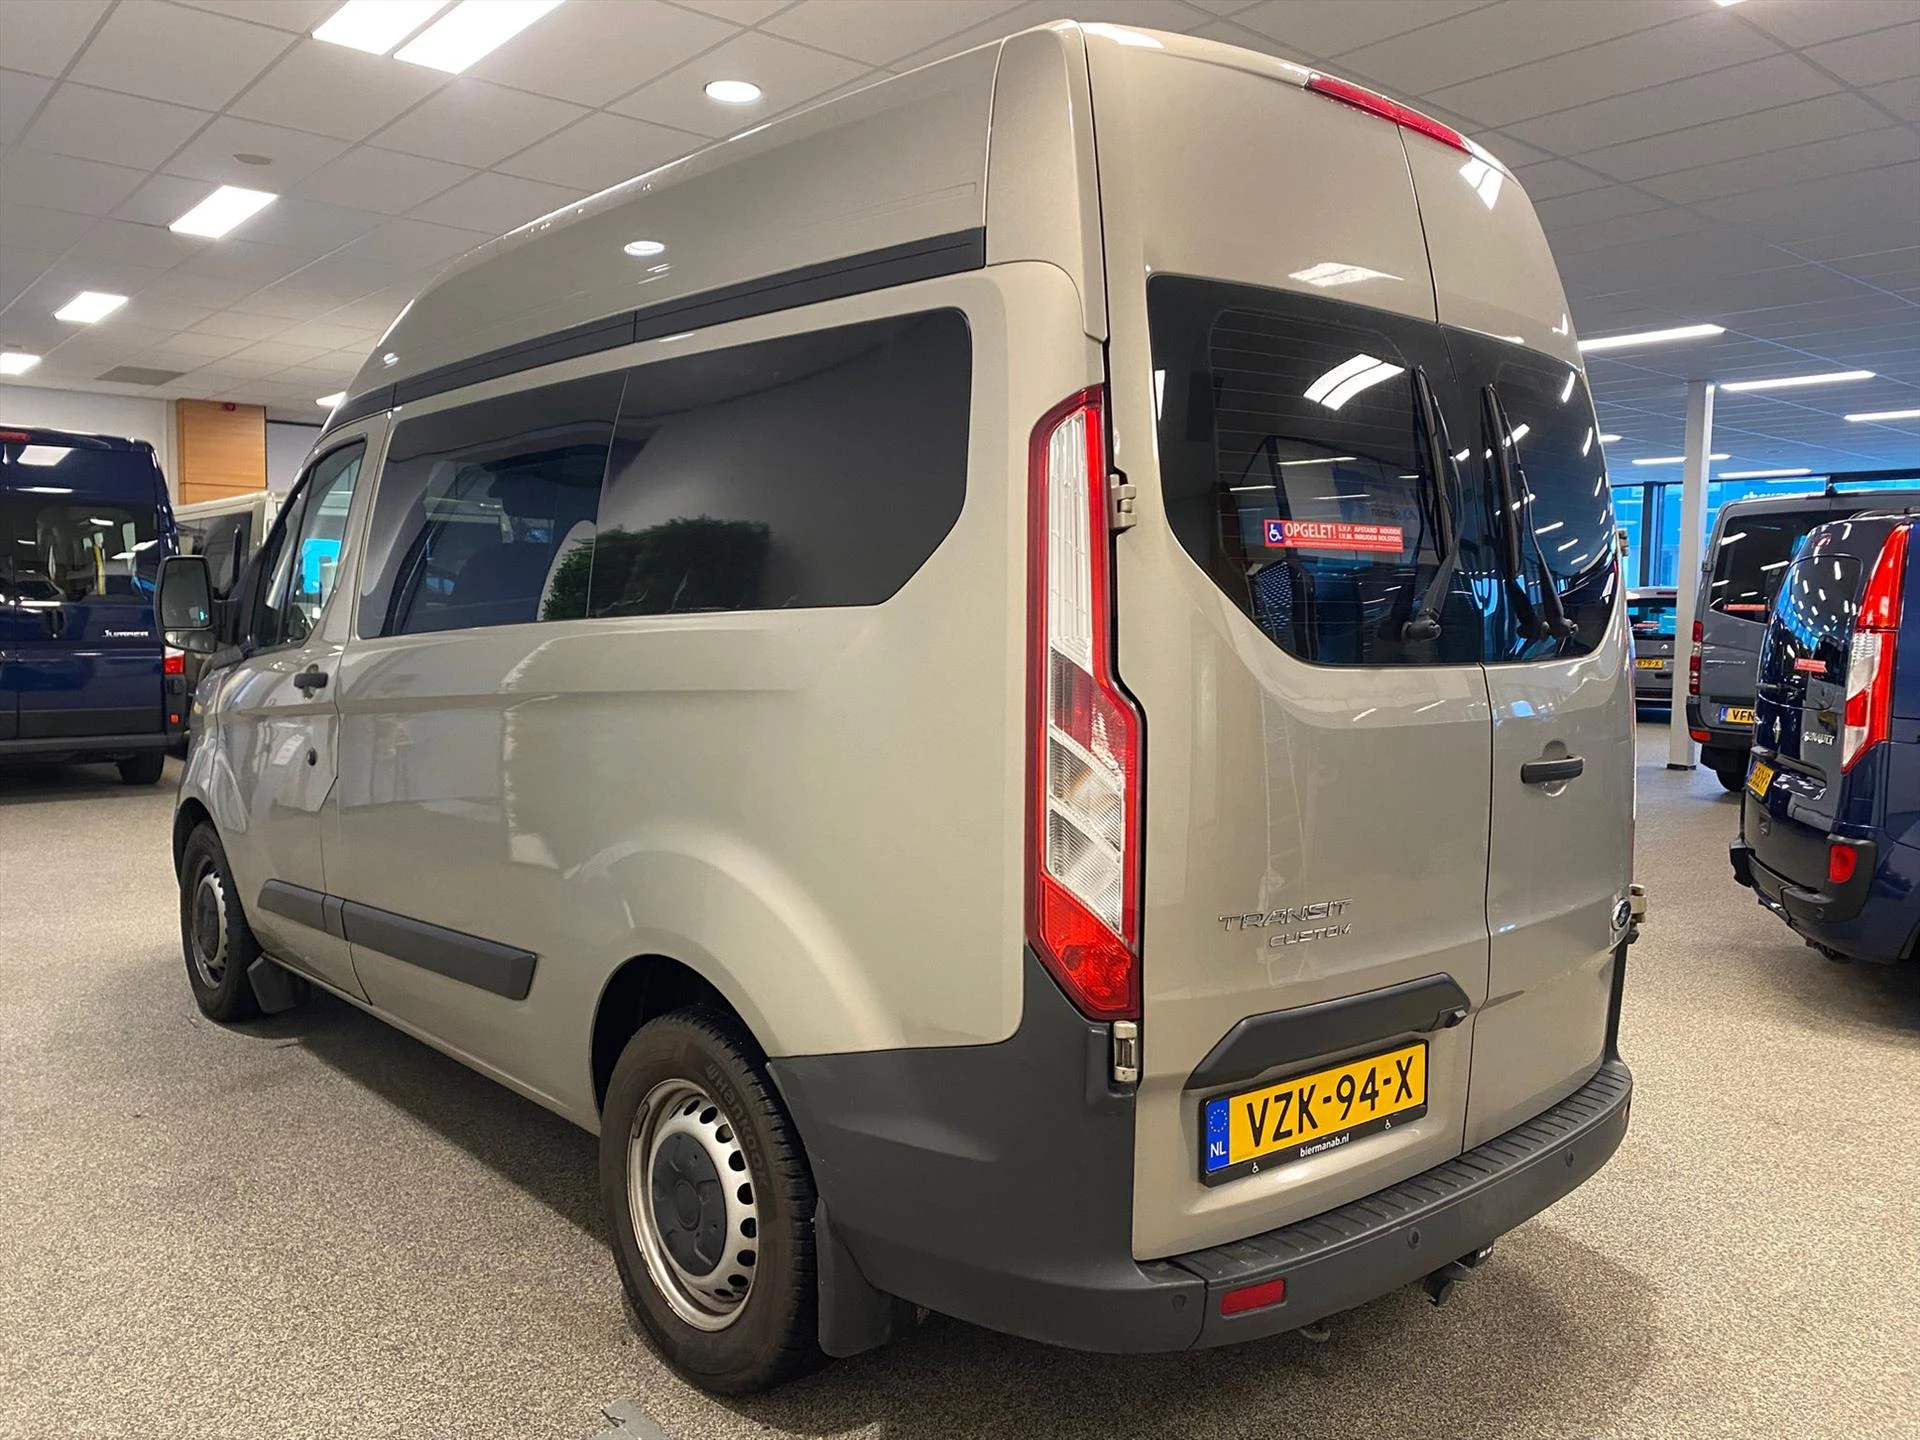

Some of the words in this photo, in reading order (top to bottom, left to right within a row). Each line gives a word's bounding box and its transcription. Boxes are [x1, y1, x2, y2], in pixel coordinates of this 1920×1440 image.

[1285, 523, 1337, 538] OPGELET!
[1218, 898, 1352, 931] TRANSIT
[1269, 923, 1351, 947] CUSTOM
[1246, 1056, 1413, 1148] VZK-94-X
[1210, 1140, 1226, 1158] NL
[1300, 1133, 1350, 1157] biermanab.nl
